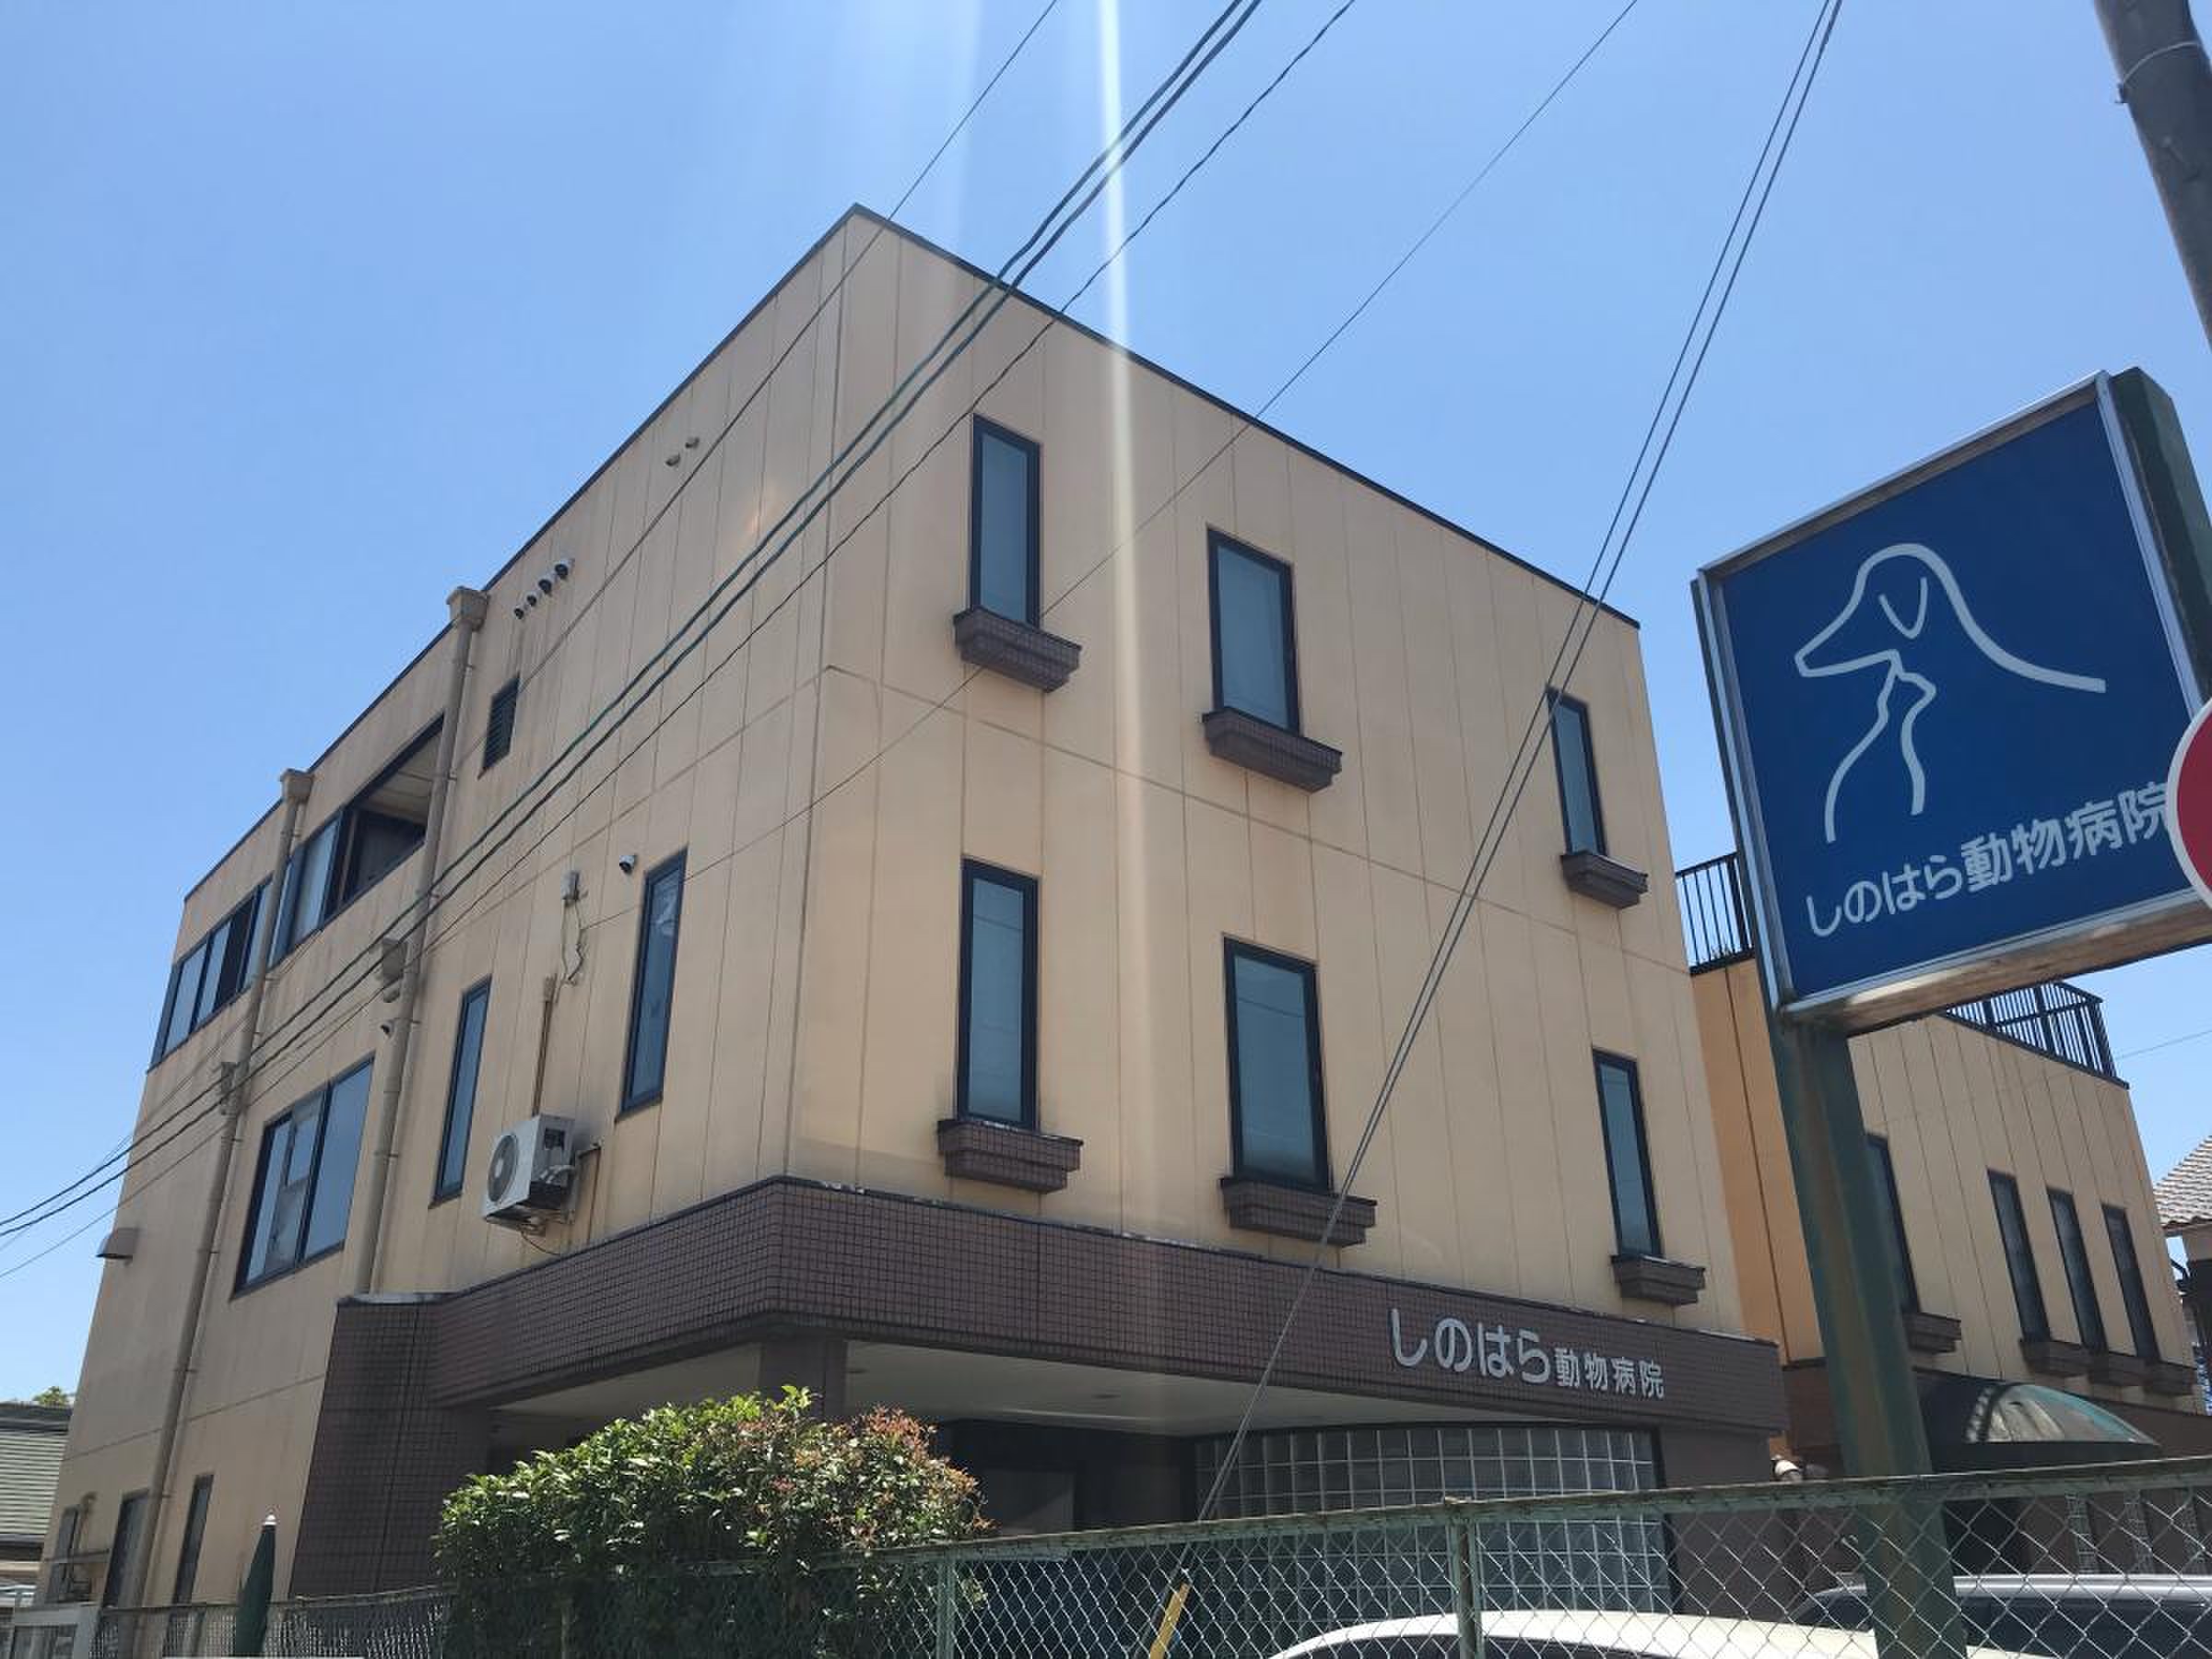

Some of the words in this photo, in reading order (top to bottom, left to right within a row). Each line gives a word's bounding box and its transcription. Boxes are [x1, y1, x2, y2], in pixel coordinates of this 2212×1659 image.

[1806, 781, 2169, 937] しのはら動物病院
[1391, 1308, 1665, 1399] しのはら動物病院
